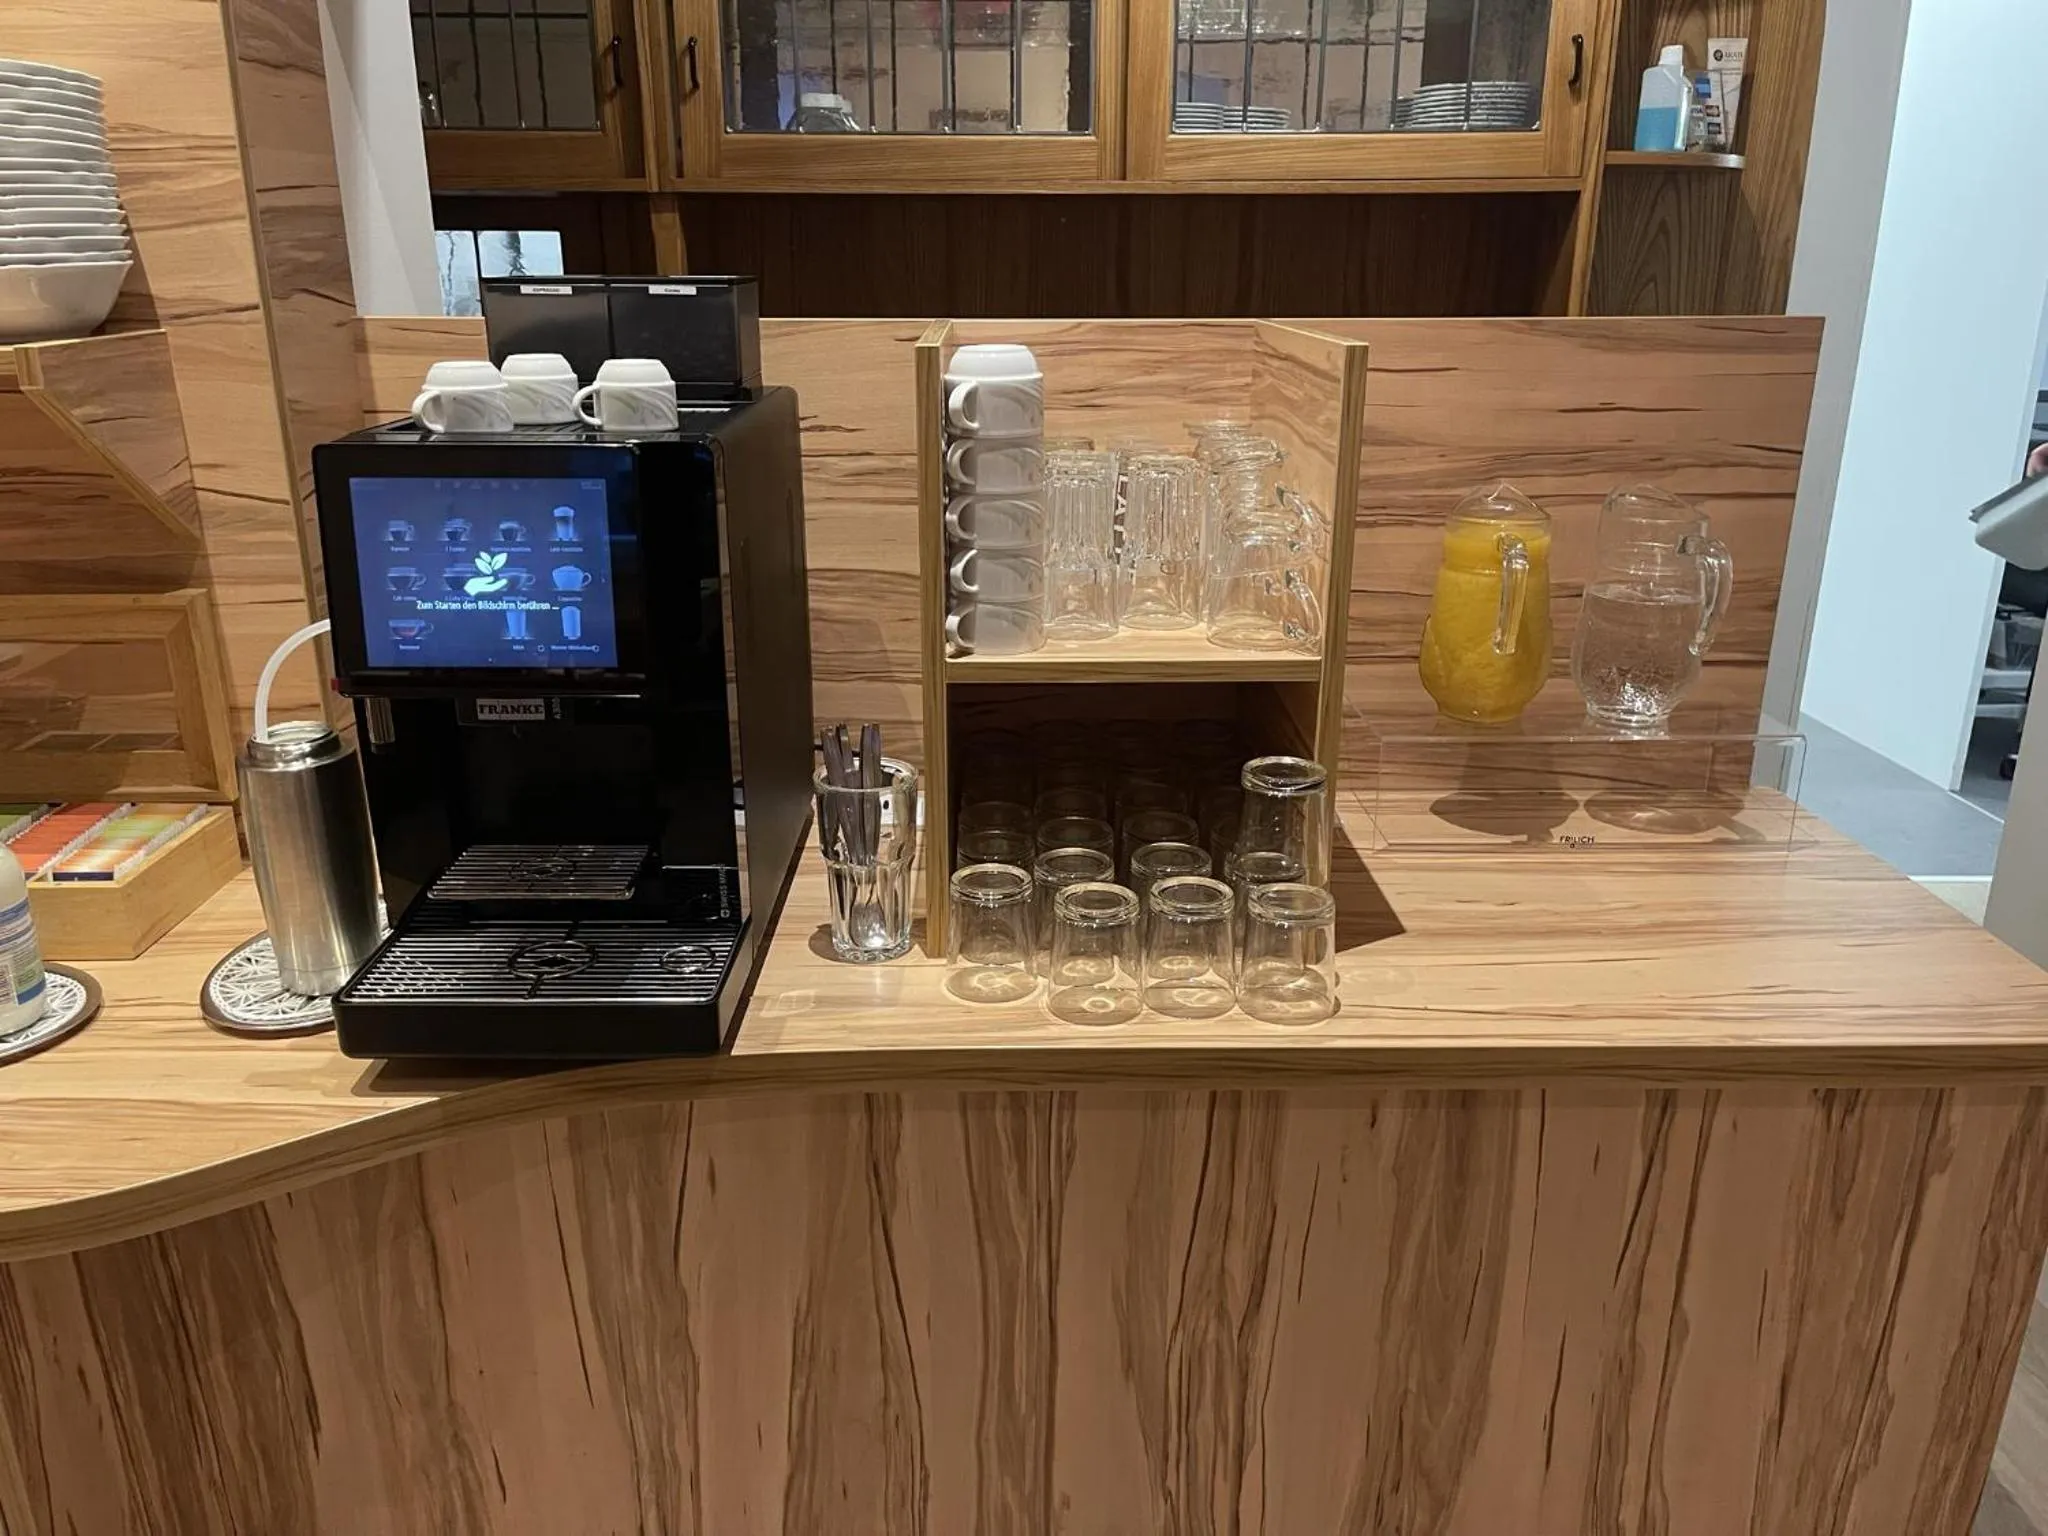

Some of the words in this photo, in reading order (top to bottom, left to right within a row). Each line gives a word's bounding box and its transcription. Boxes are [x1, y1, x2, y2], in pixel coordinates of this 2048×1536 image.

[416, 600, 434, 610] Zum
[434, 600, 461, 610] Starten
[462, 600, 477, 610] den
[477, 600, 516, 610] Bildschirm
[516, 600, 551, 610] berühren
[478, 704, 543, 715] FRANKE
